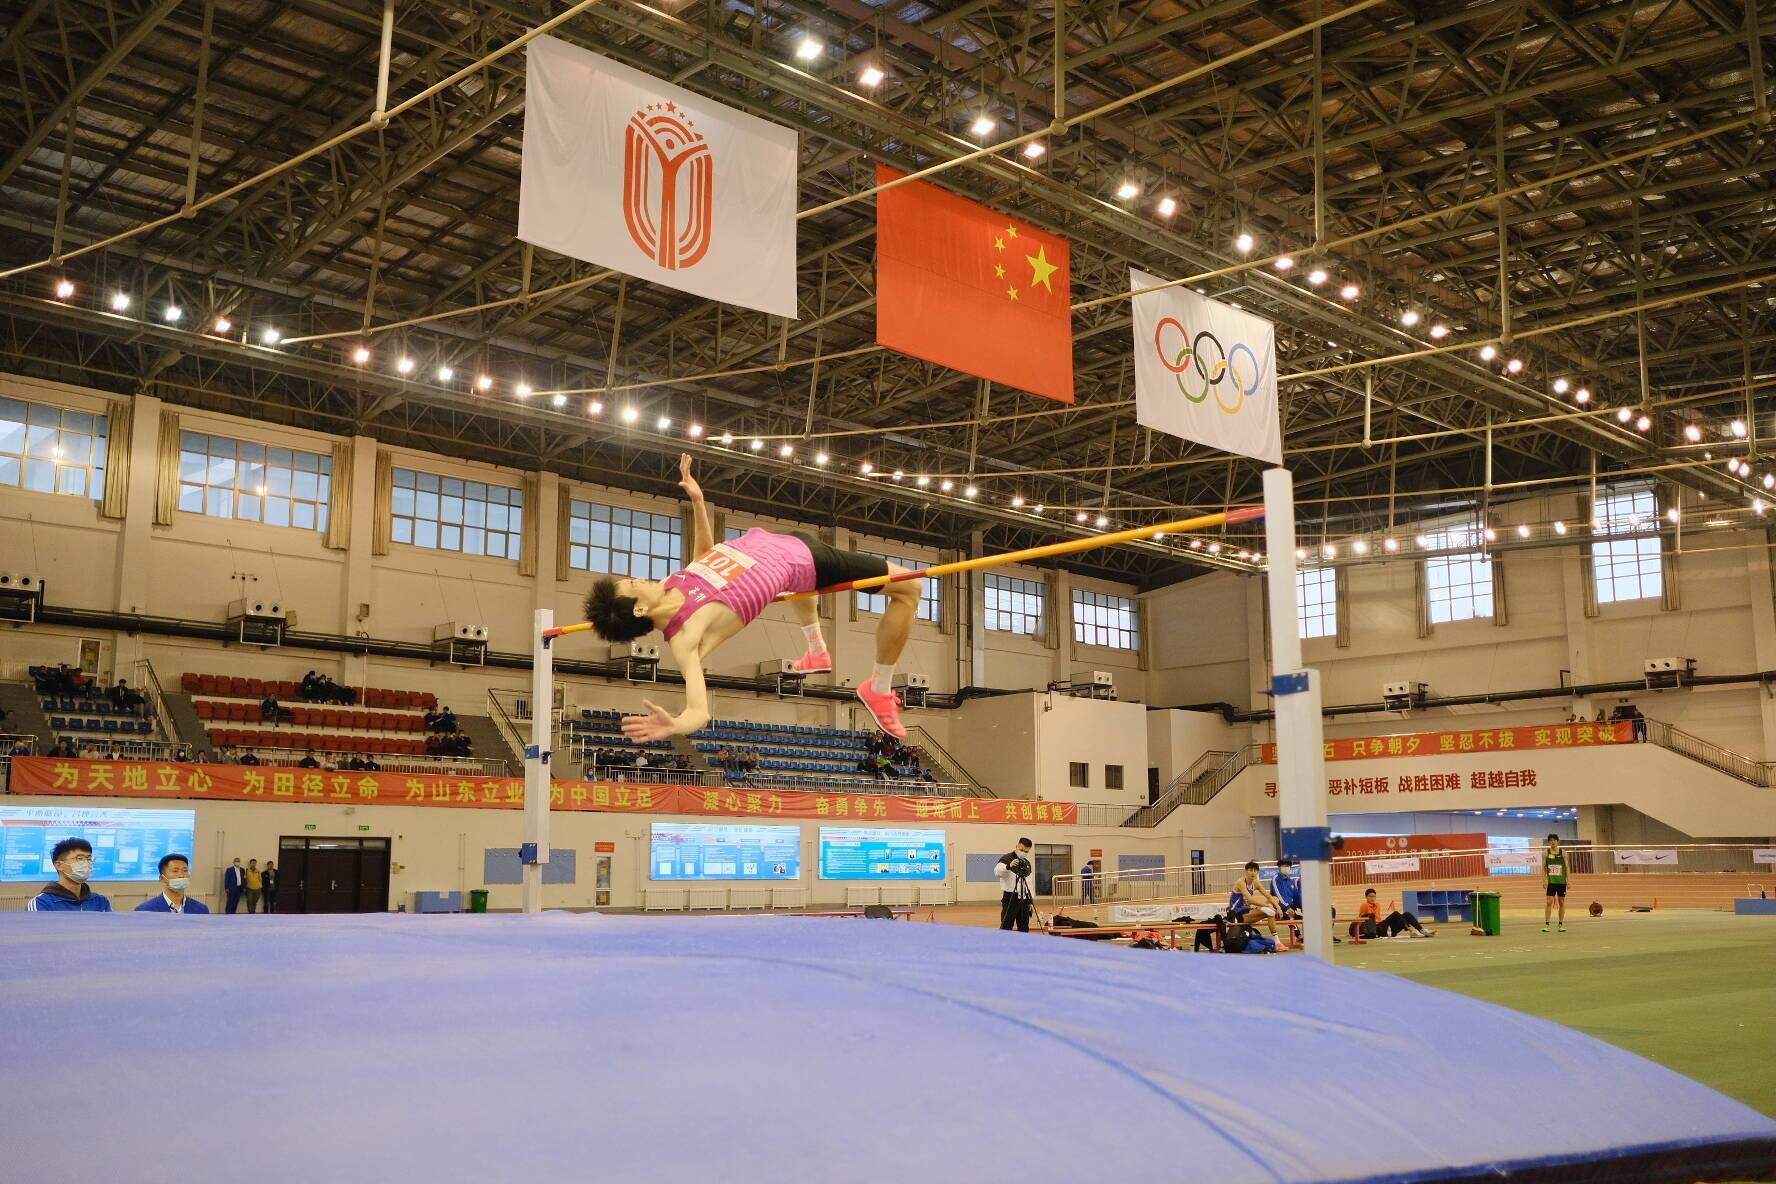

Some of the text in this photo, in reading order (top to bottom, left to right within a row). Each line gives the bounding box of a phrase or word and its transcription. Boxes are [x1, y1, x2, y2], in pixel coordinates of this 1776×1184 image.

[699, 552, 739, 577] 101
[1352, 736, 1422, 756] 只争朝夕
[1439, 731, 1515, 751] 坚忍不拔
[1534, 724, 1617, 746] 实现突破
[53, 763, 653, 808] 为天地立心 为田径立命 为山东立业 为中国立足
[1328, 776, 1390, 796] 恶补短板
[1398, 773, 1461, 793] 战胜困难
[1470, 769, 1537, 789] 超越自我
[703, 790, 783, 814] 凝心聚力
[815, 797, 887, 817] 奋勇争先
[1005, 802, 1064, 821] 共创辉煌
